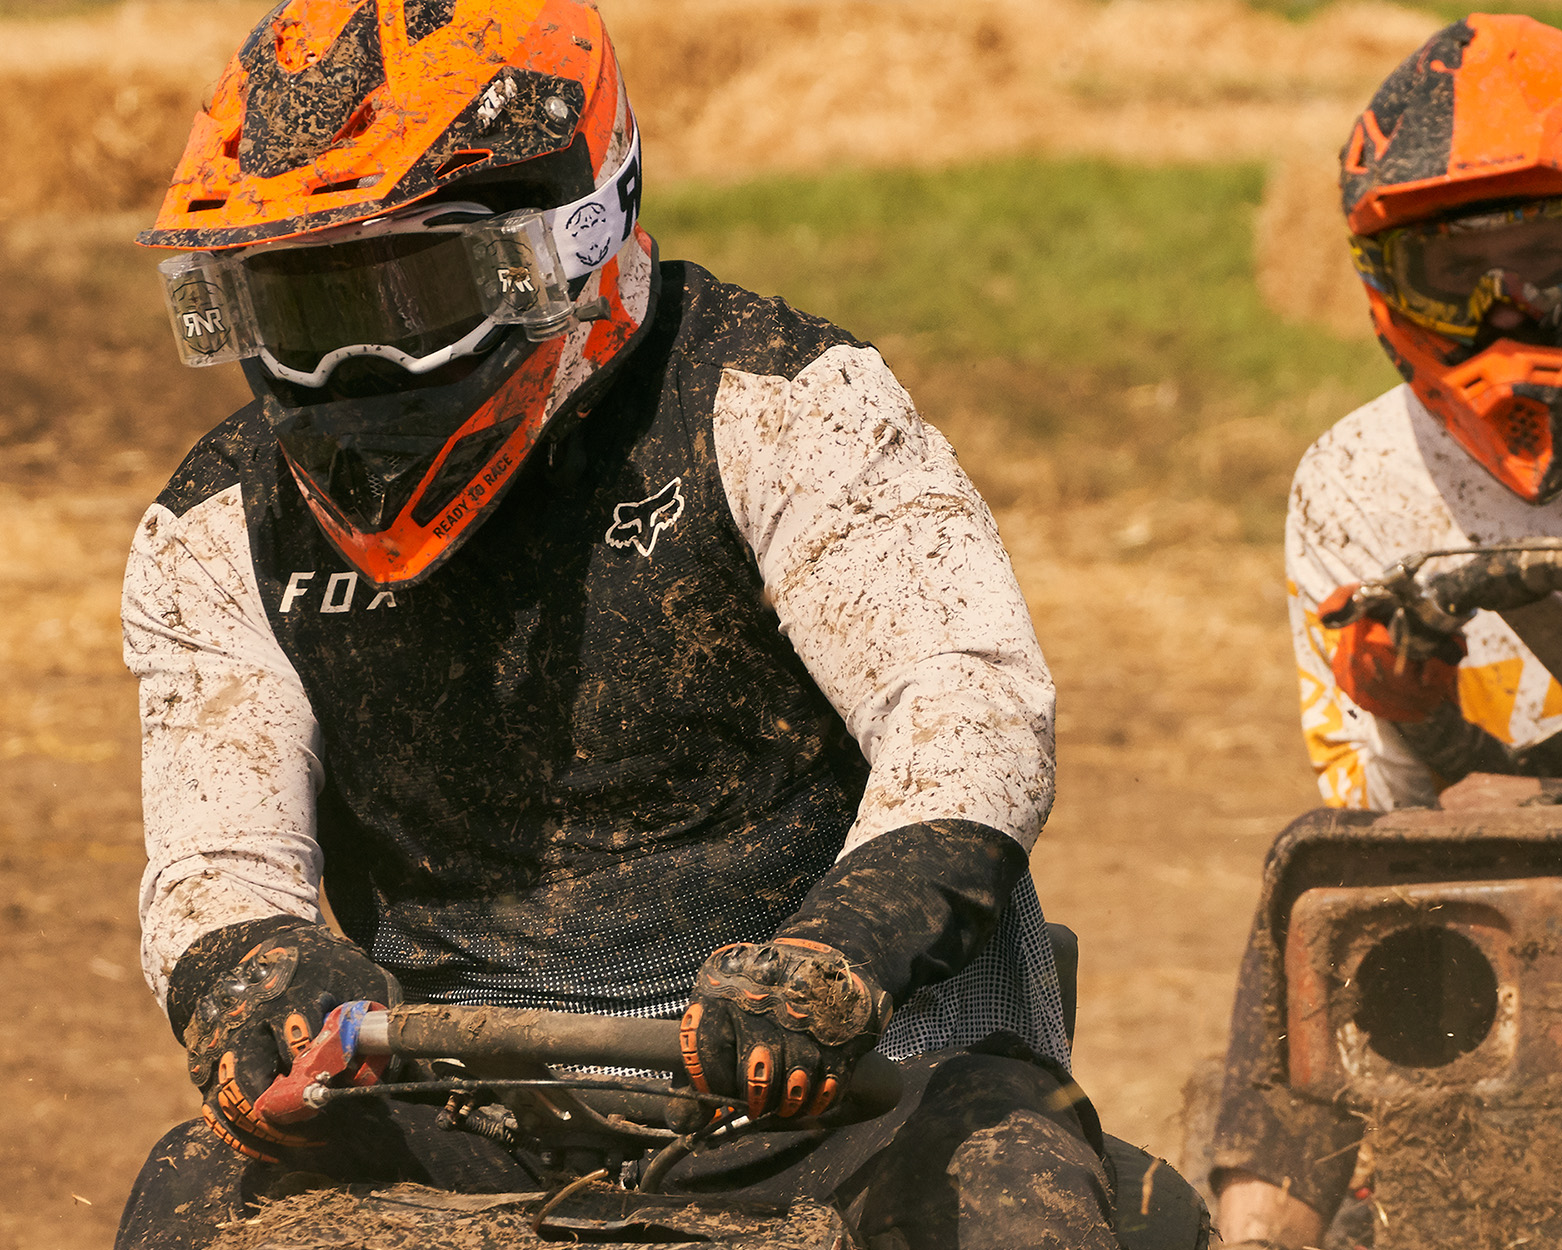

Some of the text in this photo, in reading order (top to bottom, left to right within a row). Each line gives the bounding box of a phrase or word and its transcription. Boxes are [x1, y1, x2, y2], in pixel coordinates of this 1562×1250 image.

[182, 307, 226, 338] RNR
[432, 453, 513, 539] READY TO RACE
